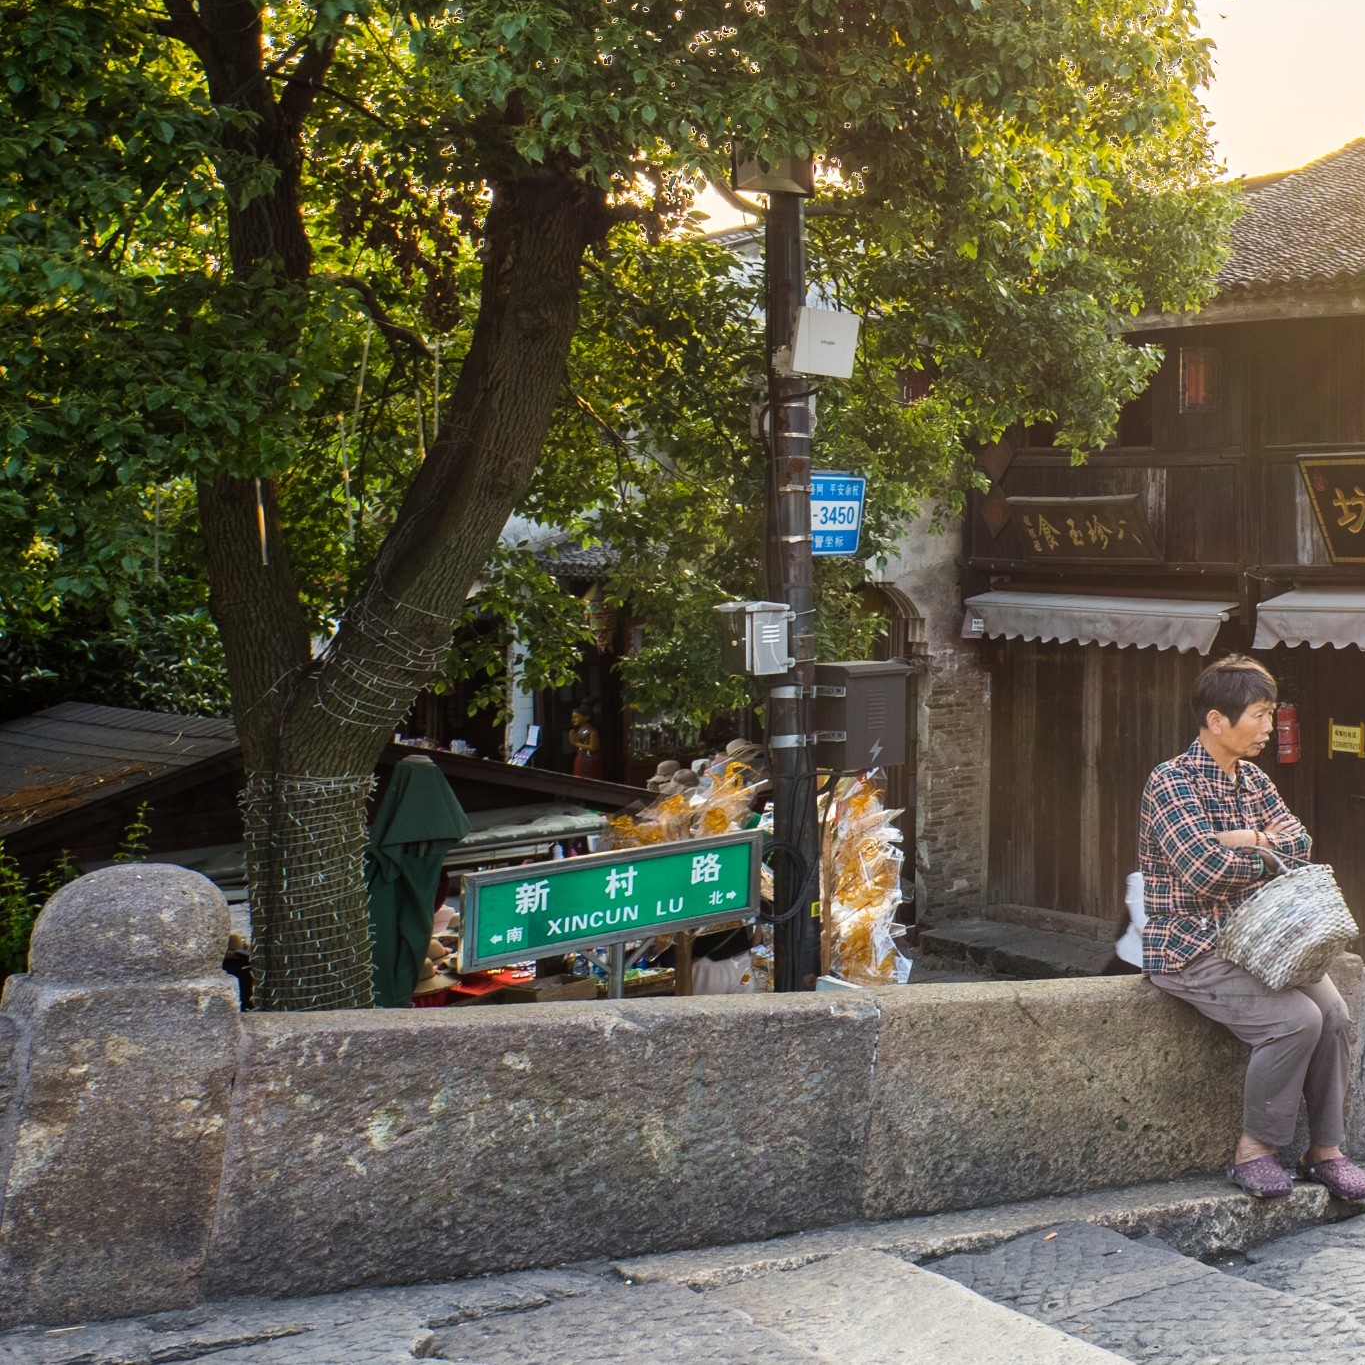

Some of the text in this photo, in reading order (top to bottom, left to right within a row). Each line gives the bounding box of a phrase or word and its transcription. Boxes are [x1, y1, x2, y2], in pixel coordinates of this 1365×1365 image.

[811, 535, 844, 549] 警坐标
[515, 854, 721, 915] 新村路
[708, 890, 724, 905] 北
[547, 897, 685, 937] XINCUN LU
[507, 927, 523, 944] 南
